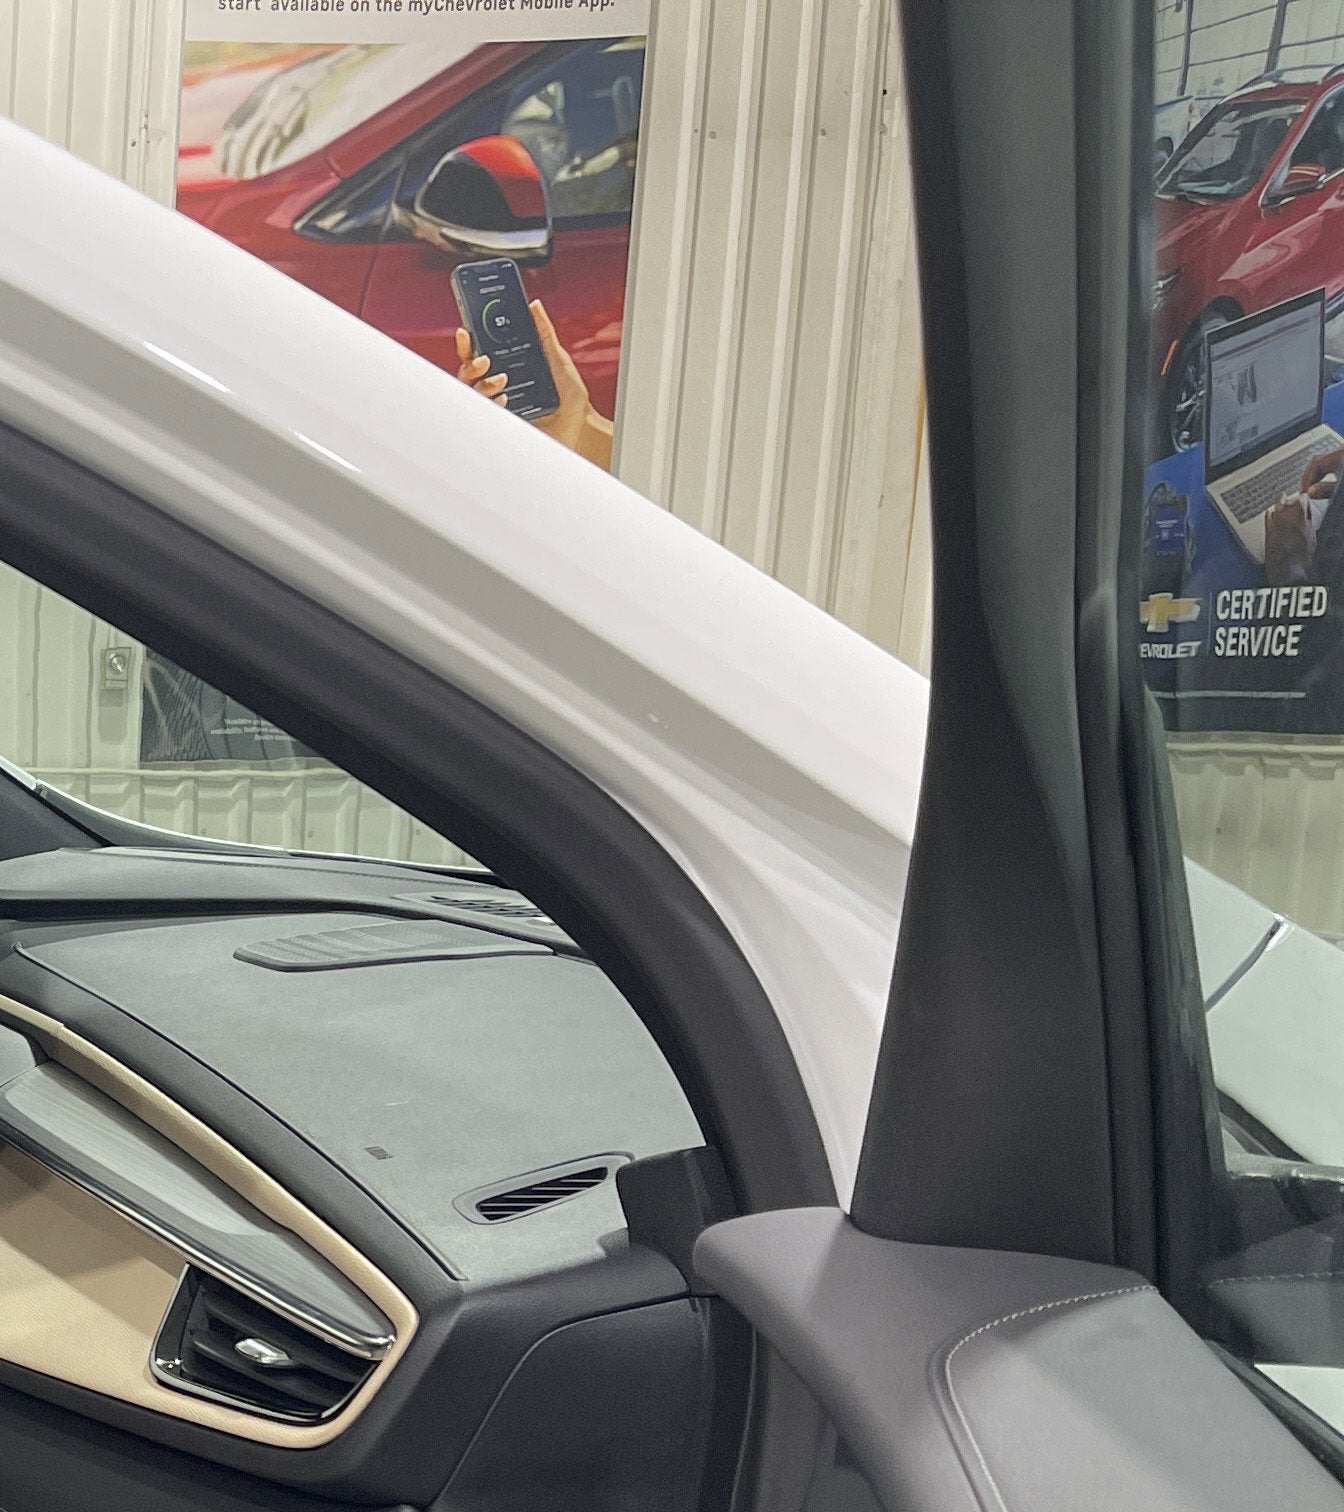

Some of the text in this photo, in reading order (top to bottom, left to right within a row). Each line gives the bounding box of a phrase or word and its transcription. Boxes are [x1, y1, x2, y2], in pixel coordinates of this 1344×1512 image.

[218, 0, 262, 10] start
[270, 0, 345, 11] available
[350, 0, 370, 11] on
[376, 0, 403, 11] the
[408, 0, 515, 15] myChevrolet
[1216, 586, 1328, 620] CERTIFIED
[1139, 641, 1202, 659] EVROLET
[1214, 624, 1303, 657] SERVICE
